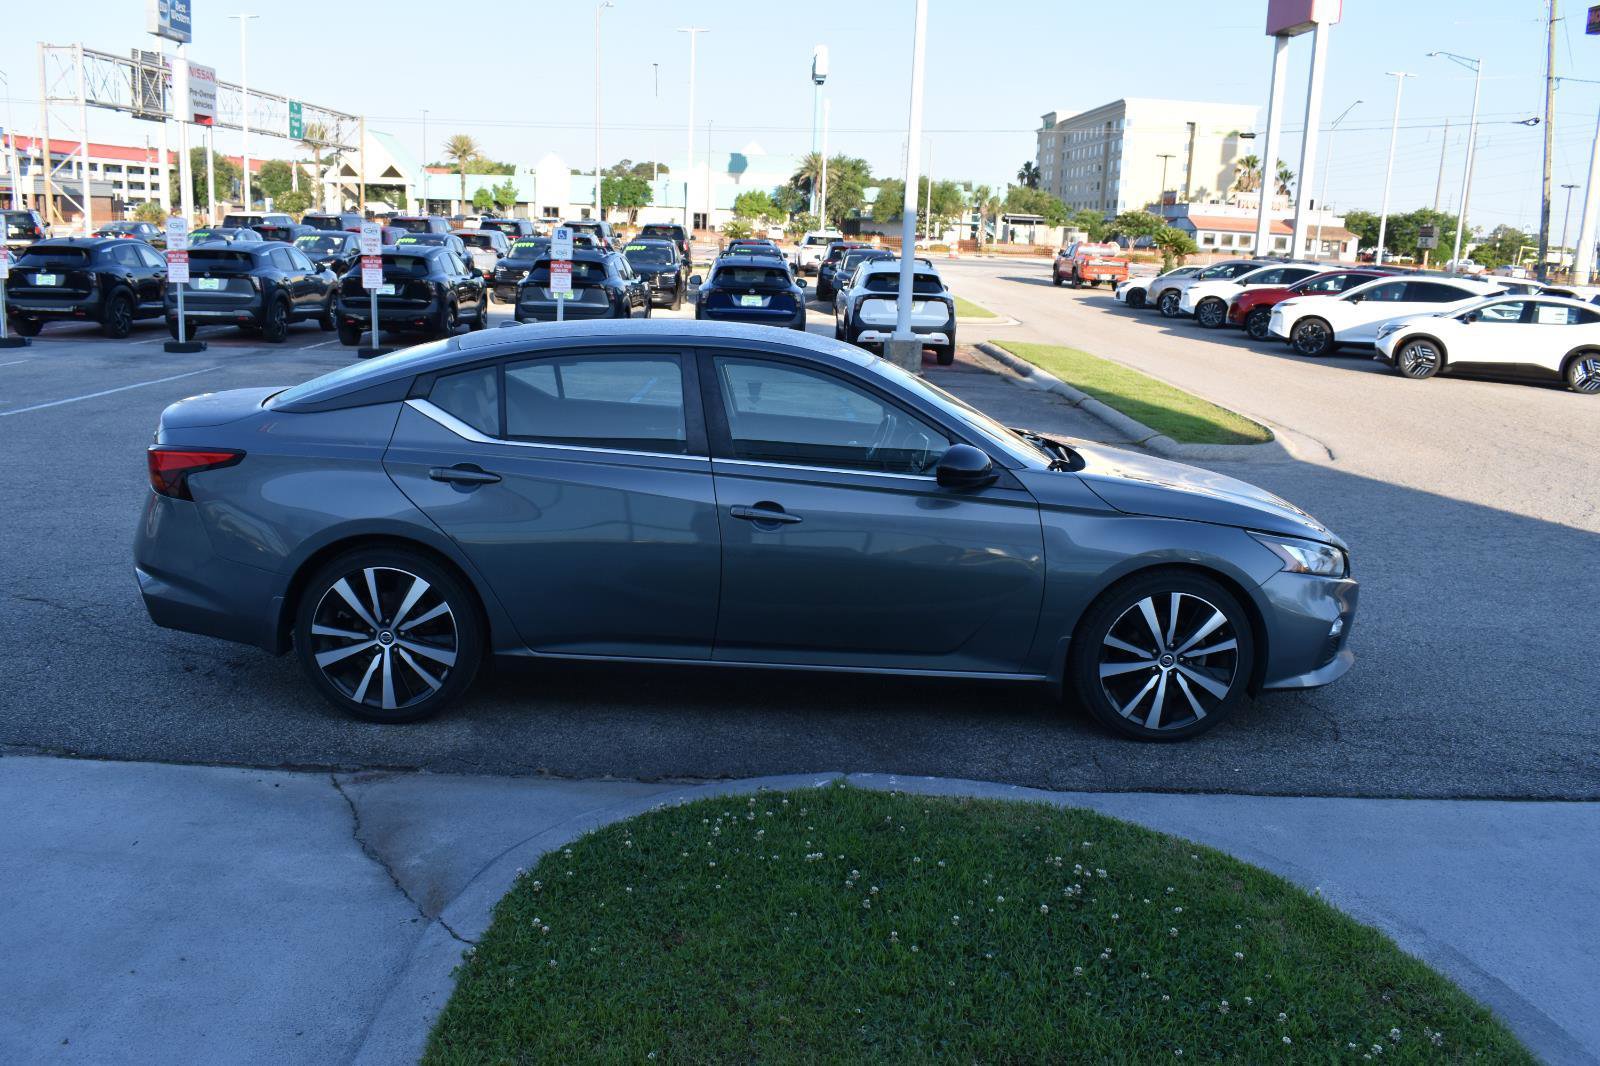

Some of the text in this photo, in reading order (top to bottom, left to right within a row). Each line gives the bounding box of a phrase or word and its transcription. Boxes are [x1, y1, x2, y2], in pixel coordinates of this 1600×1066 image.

[189, 66, 215, 81] NISSAN
[189, 87, 216, 100] Pre-Owned
[193, 99, 213, 110] Vehicles
